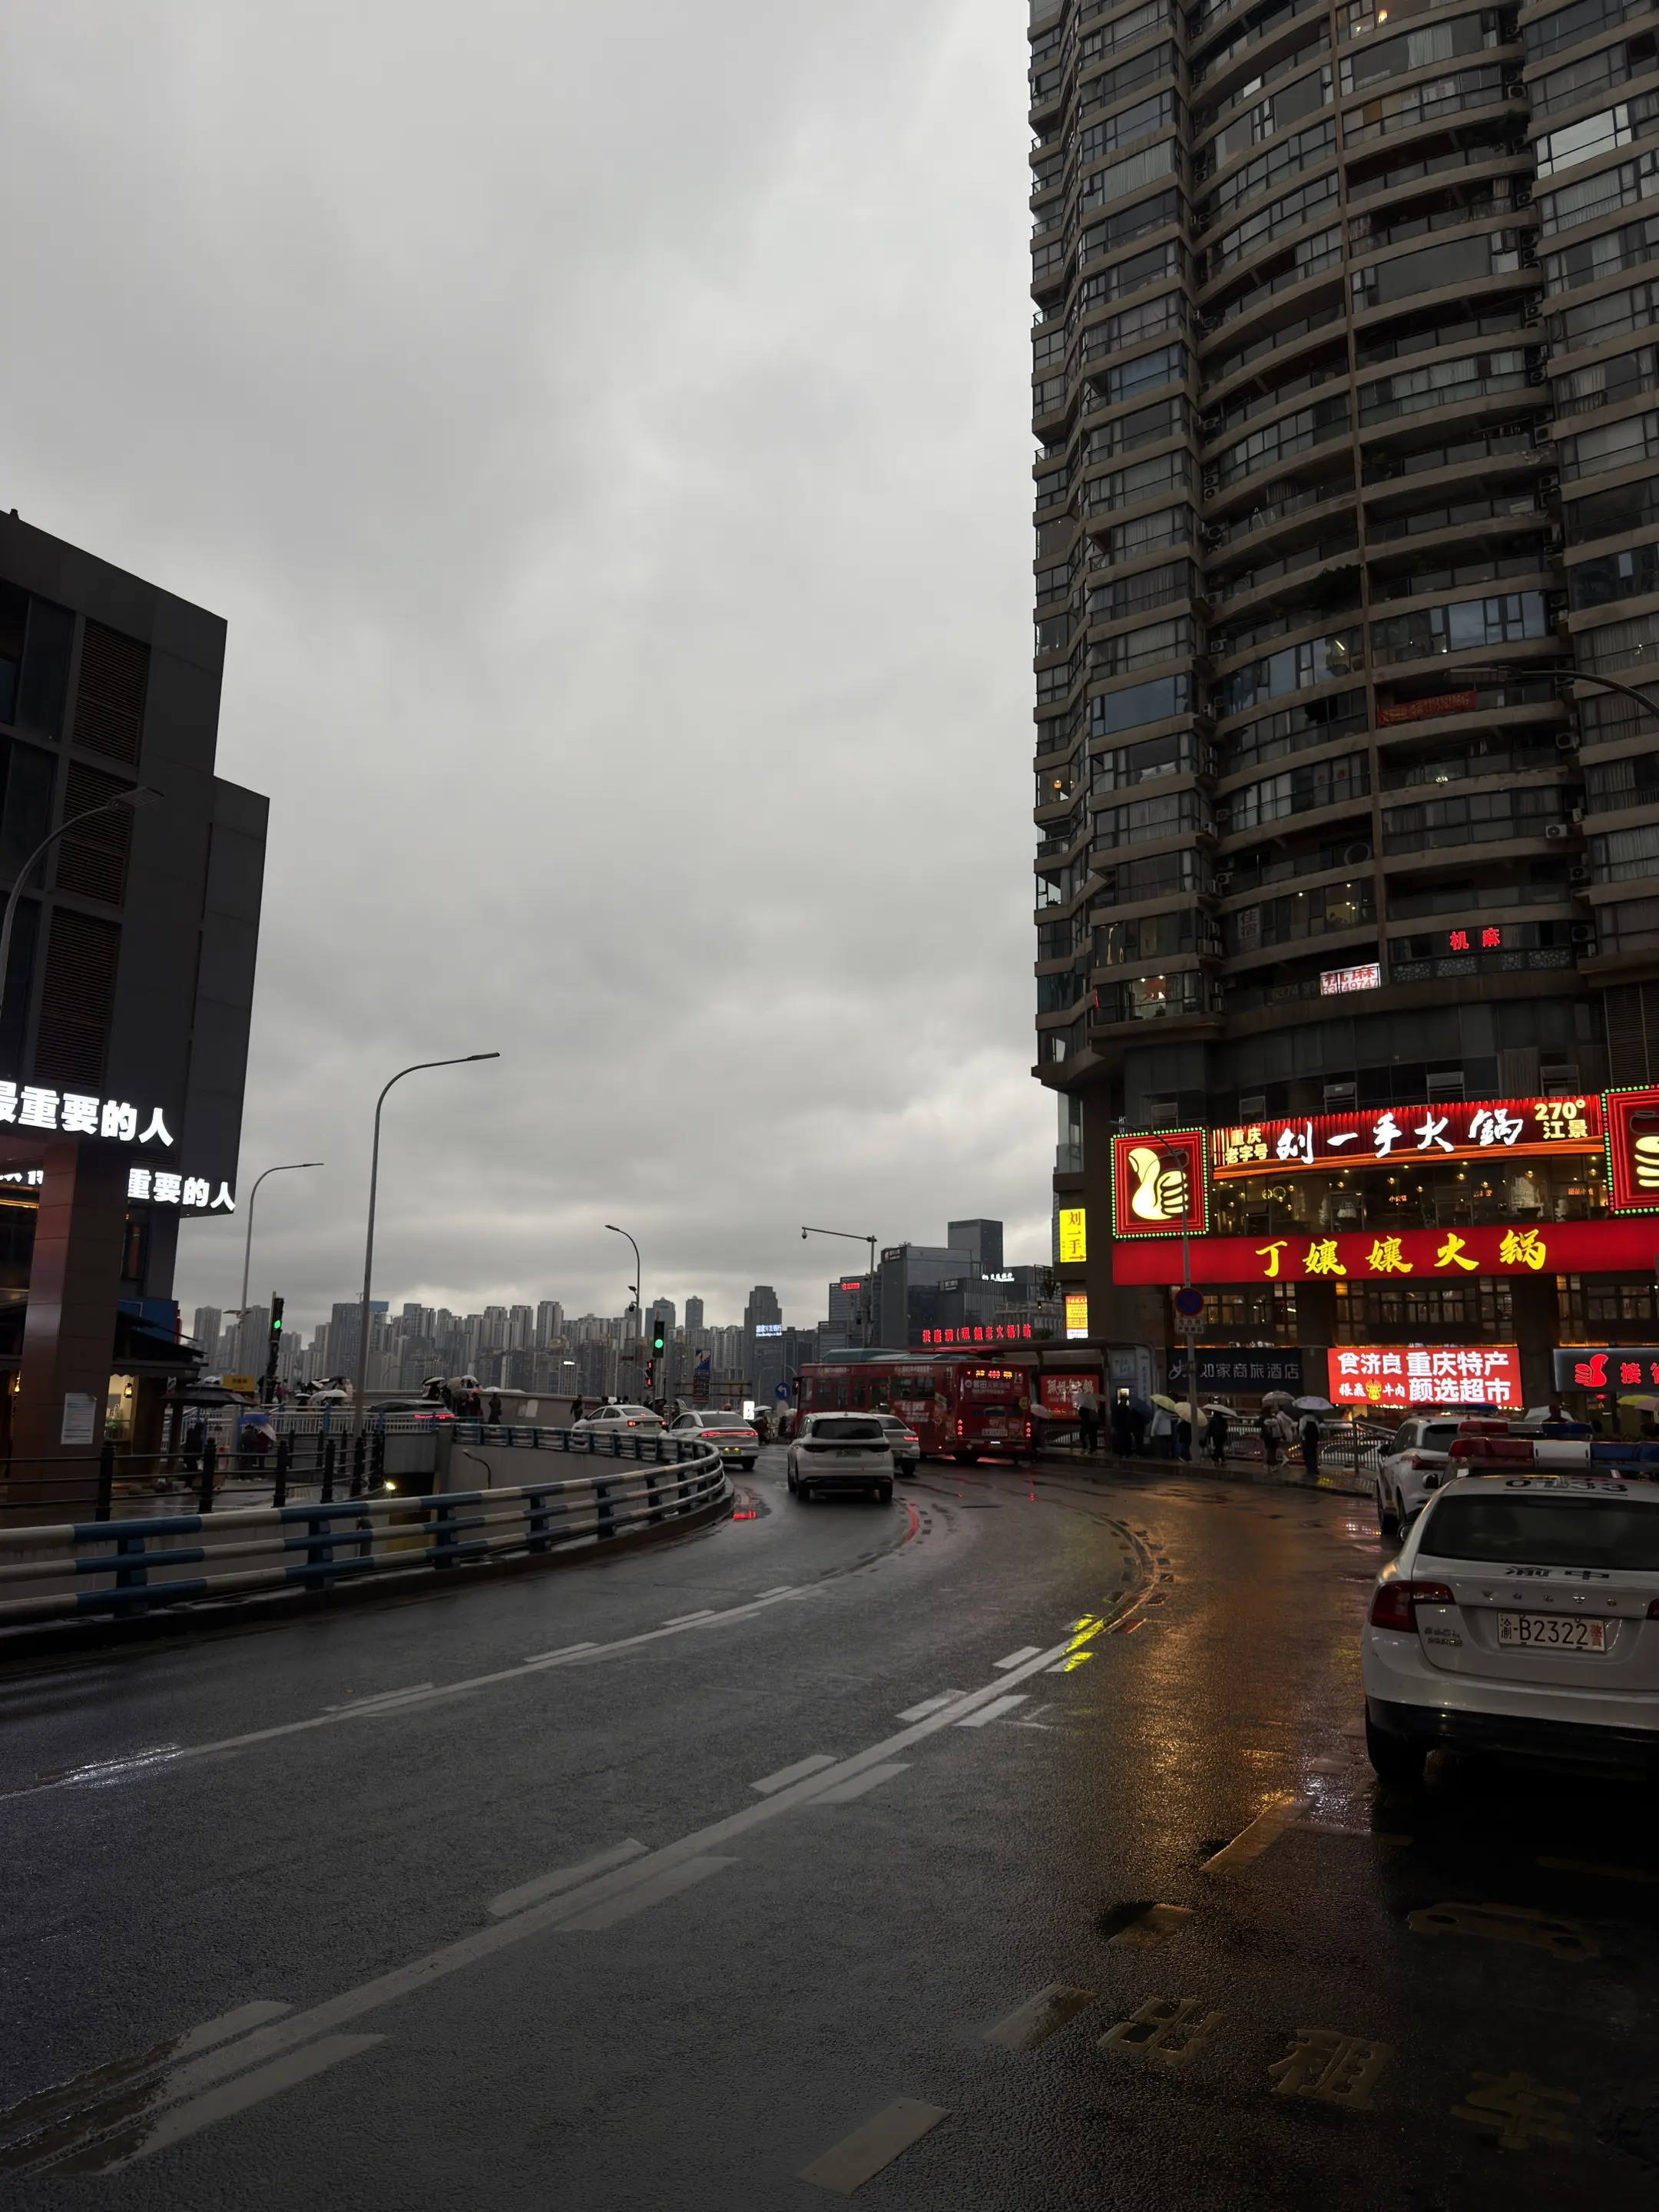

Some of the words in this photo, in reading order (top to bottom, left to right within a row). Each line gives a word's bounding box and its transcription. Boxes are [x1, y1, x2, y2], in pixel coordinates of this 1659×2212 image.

[1231, 1127, 1262, 1147] 重庆
[1543, 1119, 1588, 1139] 江景
[1225, 1143, 1268, 1164] 老字号
[127, 1167, 236, 1211] 重要的人
[1067, 1211, 1081, 1254] 刘一手
[1337, 1352, 1402, 1375] 食济良
[1406, 1351, 1508, 1376] 重庆特产
[1409, 1377, 1512, 1404] 颜选超市
